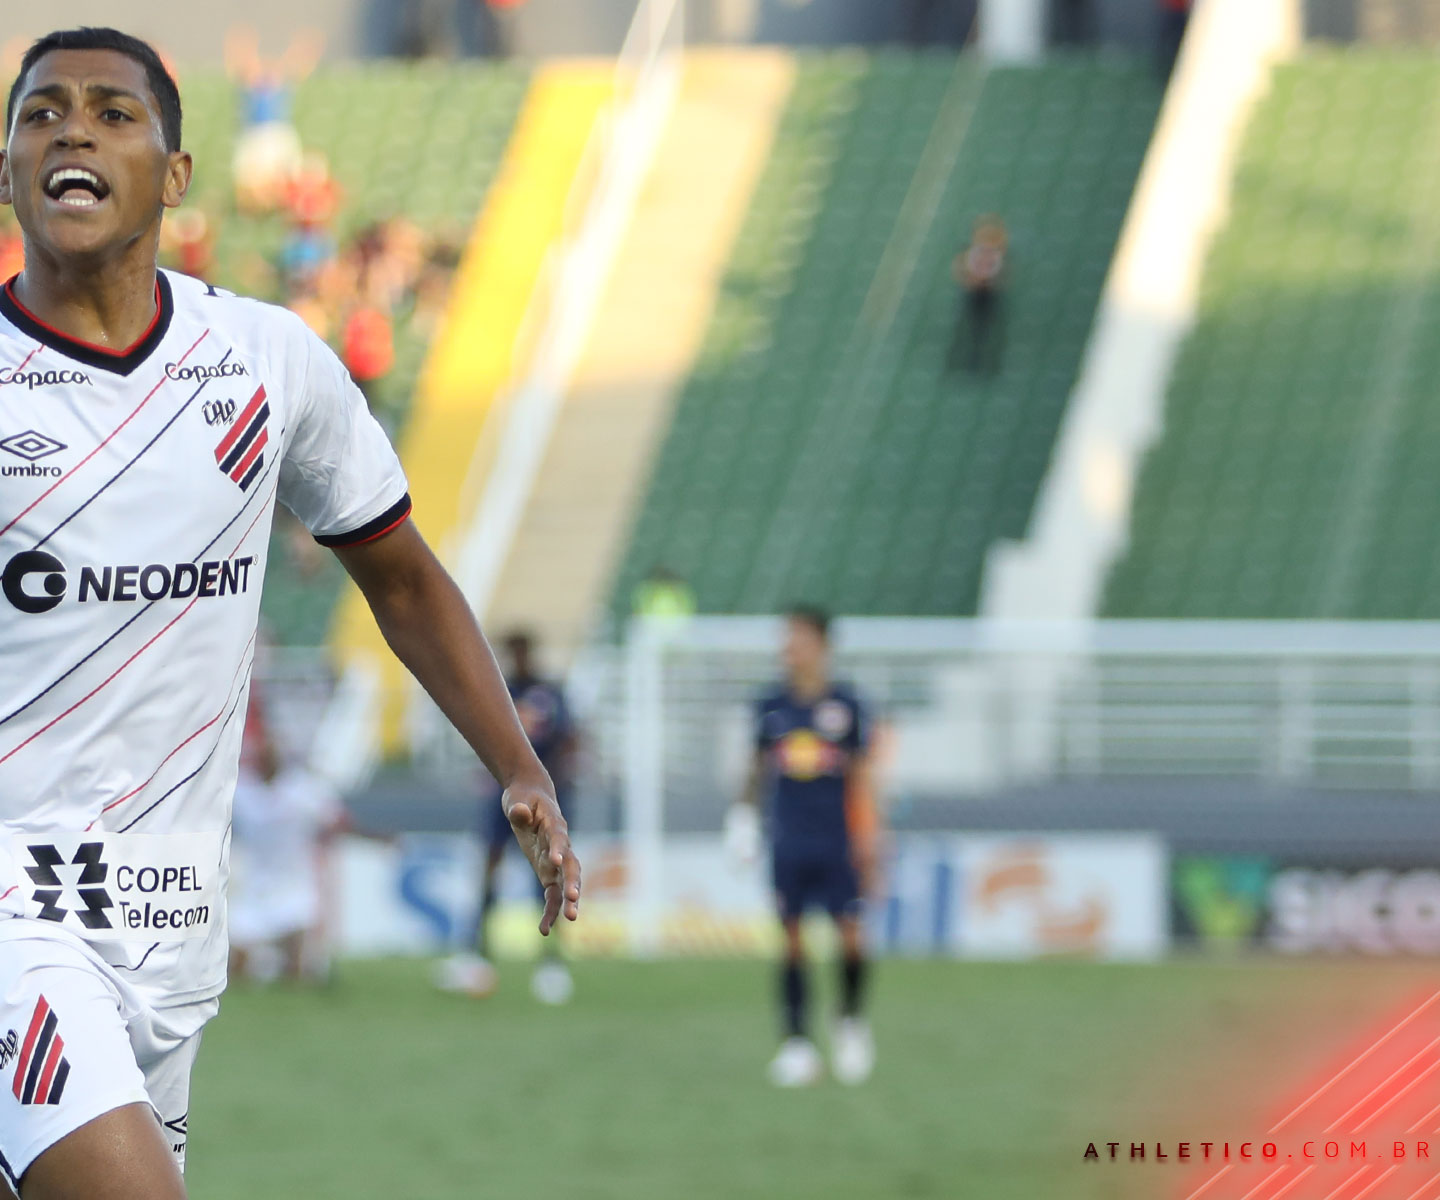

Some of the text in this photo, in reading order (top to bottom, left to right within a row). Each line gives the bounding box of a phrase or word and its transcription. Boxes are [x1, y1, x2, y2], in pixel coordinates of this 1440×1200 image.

[1, 463, 62, 477] umbro
[78, 556, 254, 603] NEODENT
[117, 865, 202, 893] COPEL
[118, 901, 209, 929] Telecom
